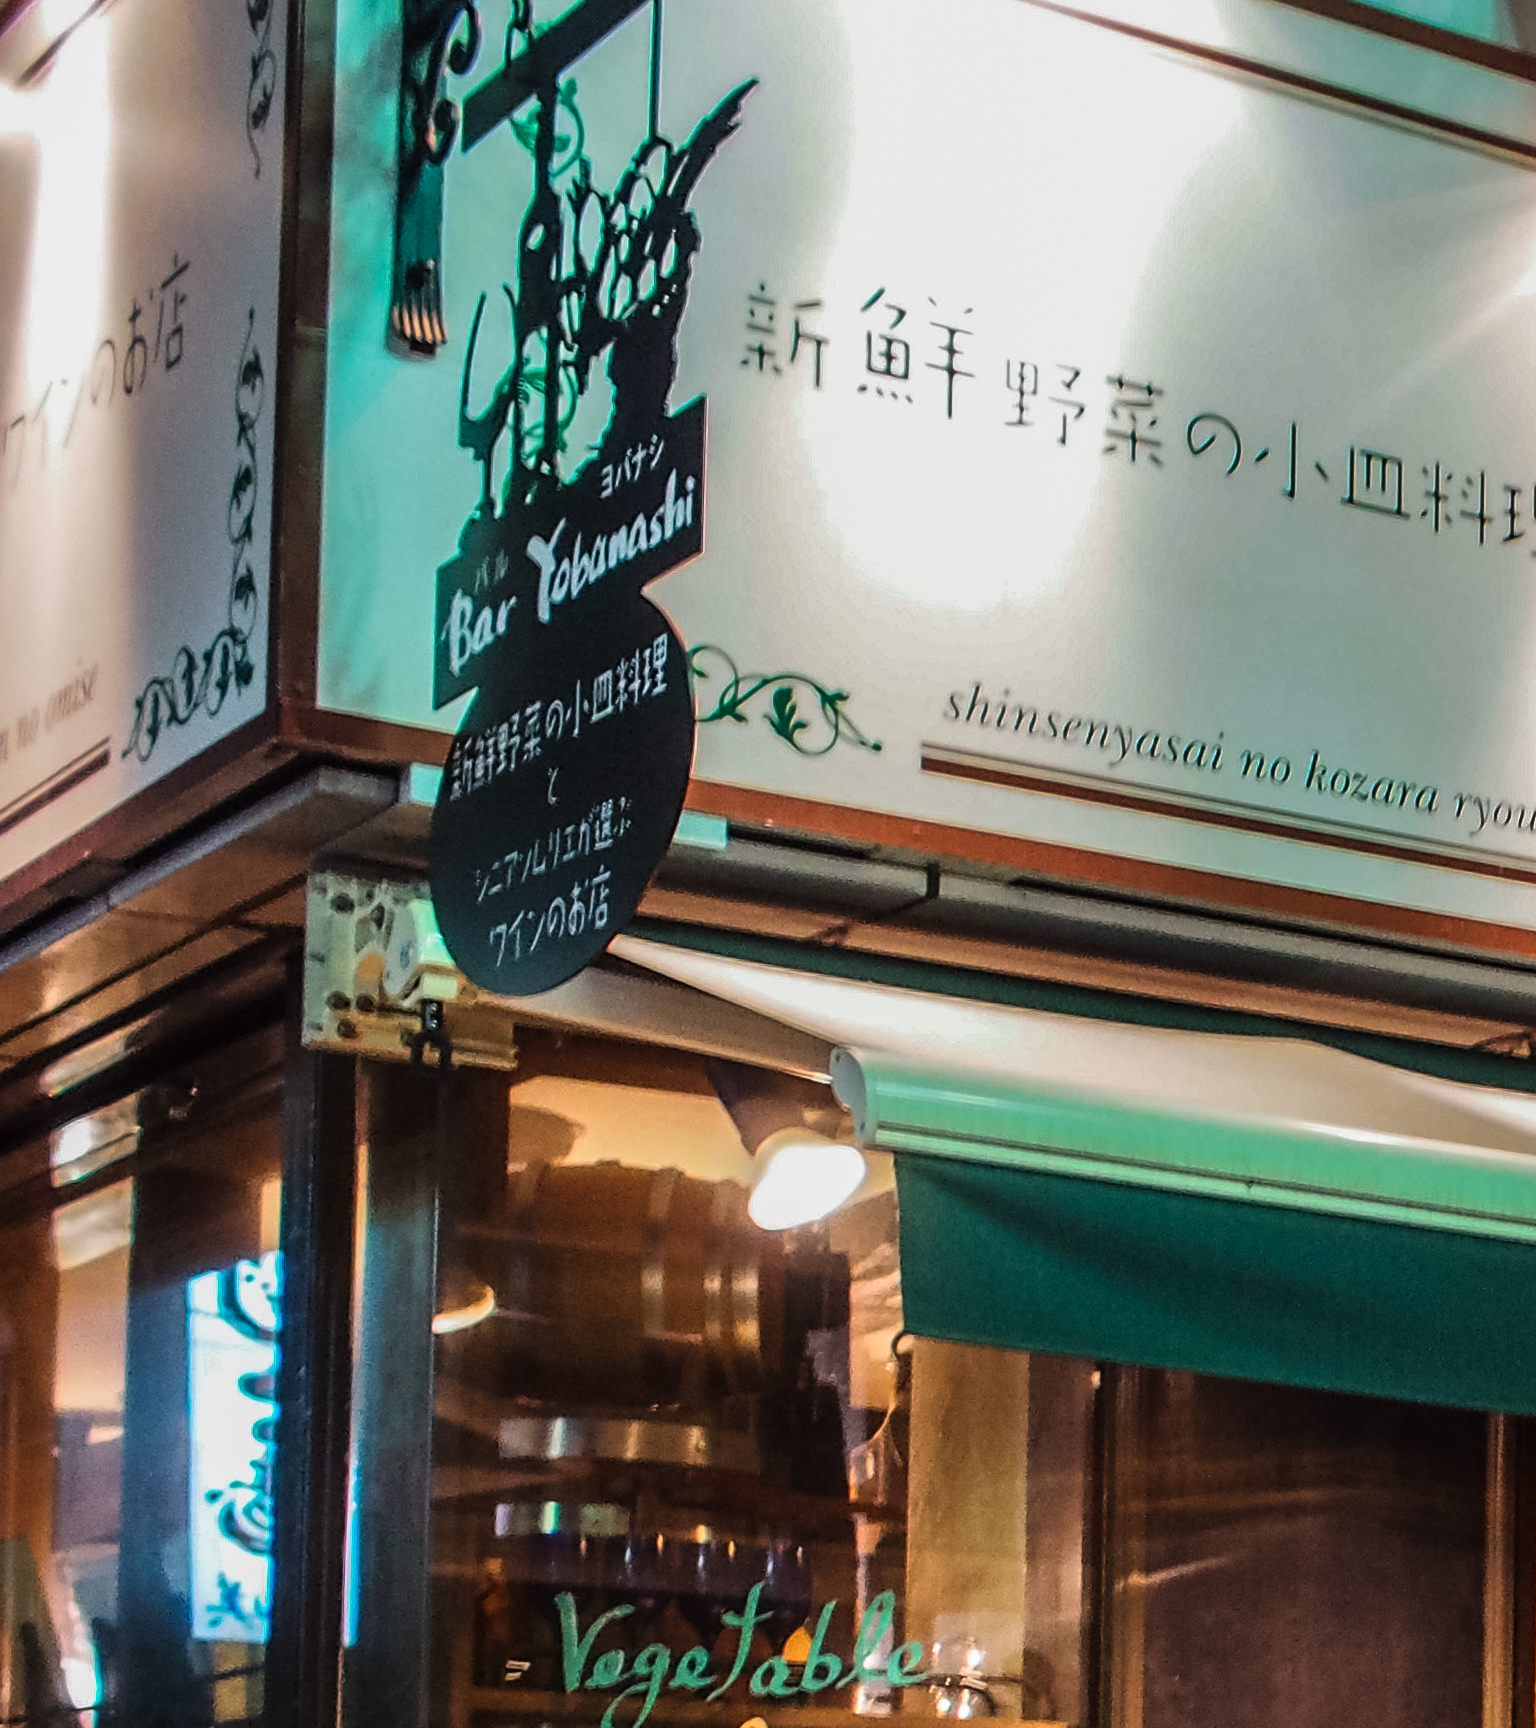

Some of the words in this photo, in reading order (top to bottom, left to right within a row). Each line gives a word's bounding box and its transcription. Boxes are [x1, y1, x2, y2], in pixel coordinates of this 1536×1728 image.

[527, 467, 696, 624] Yobanashi
[440, 589, 518, 678] Bar
[943, 681, 1226, 772] shinsenyasai
[1240, 748, 1291, 786] no
[1305, 748, 1440, 815] kozara
[489, 864, 611, 967] ワインのお店
